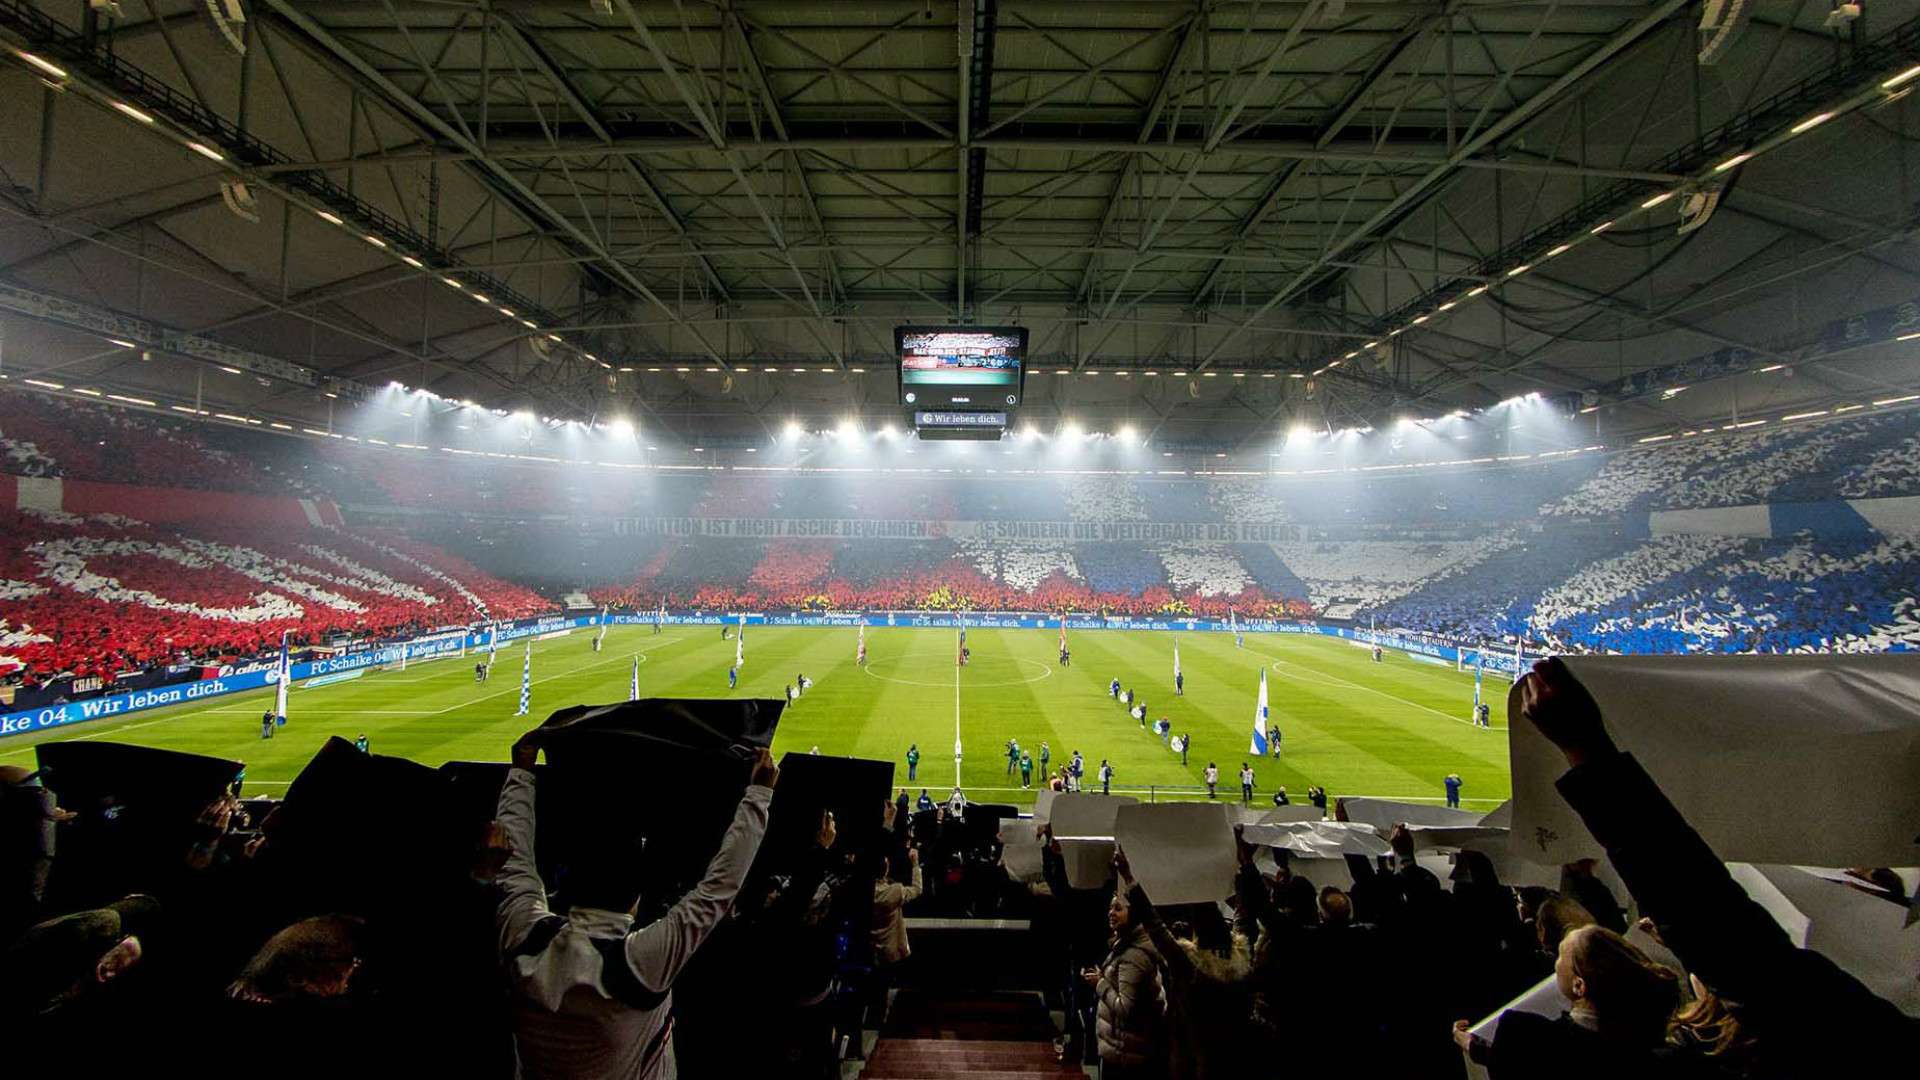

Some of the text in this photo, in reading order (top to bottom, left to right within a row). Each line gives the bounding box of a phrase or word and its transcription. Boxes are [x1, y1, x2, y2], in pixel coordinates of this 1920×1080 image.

[935, 415, 999, 423] Wir leben dich.
[616, 518, 927, 538] TRADITION IST NICHT ASCHE BEWAHREN
[996, 521, 1300, 542] SONDERN DIE WEITERGABE DES FEUERS
[614, 615, 625, 624] FC
[626, 615, 655, 624] Schalke
[668, 615, 681, 624] Wir
[683, 615, 702, 624] leben
[704, 615, 722, 624] dich.
[775, 616, 802, 625] Schalke
[816, 616, 829, 625] Wir
[831, 616, 851, 625] leben
[965, 619, 978, 627] Wir
[980, 619, 1000, 627] leben
[1002, 619, 1021, 628] dich.
[1072, 620, 1100, 629] Schalke
[1114, 621, 1128, 629] Wir
[1130, 621, 1149, 629] leben
[1151, 621, 1170, 630] dich.
[1265, 623, 1278, 631] Wir
[311, 660, 327, 675] FC
[329, 654, 373, 672] Schalke
[411, 642, 436, 657] leben
[39, 707, 73, 726] 04.
[81, 699, 122, 717] Wir
[128, 690, 181, 709] leben
[186, 680, 229, 698] dich.
